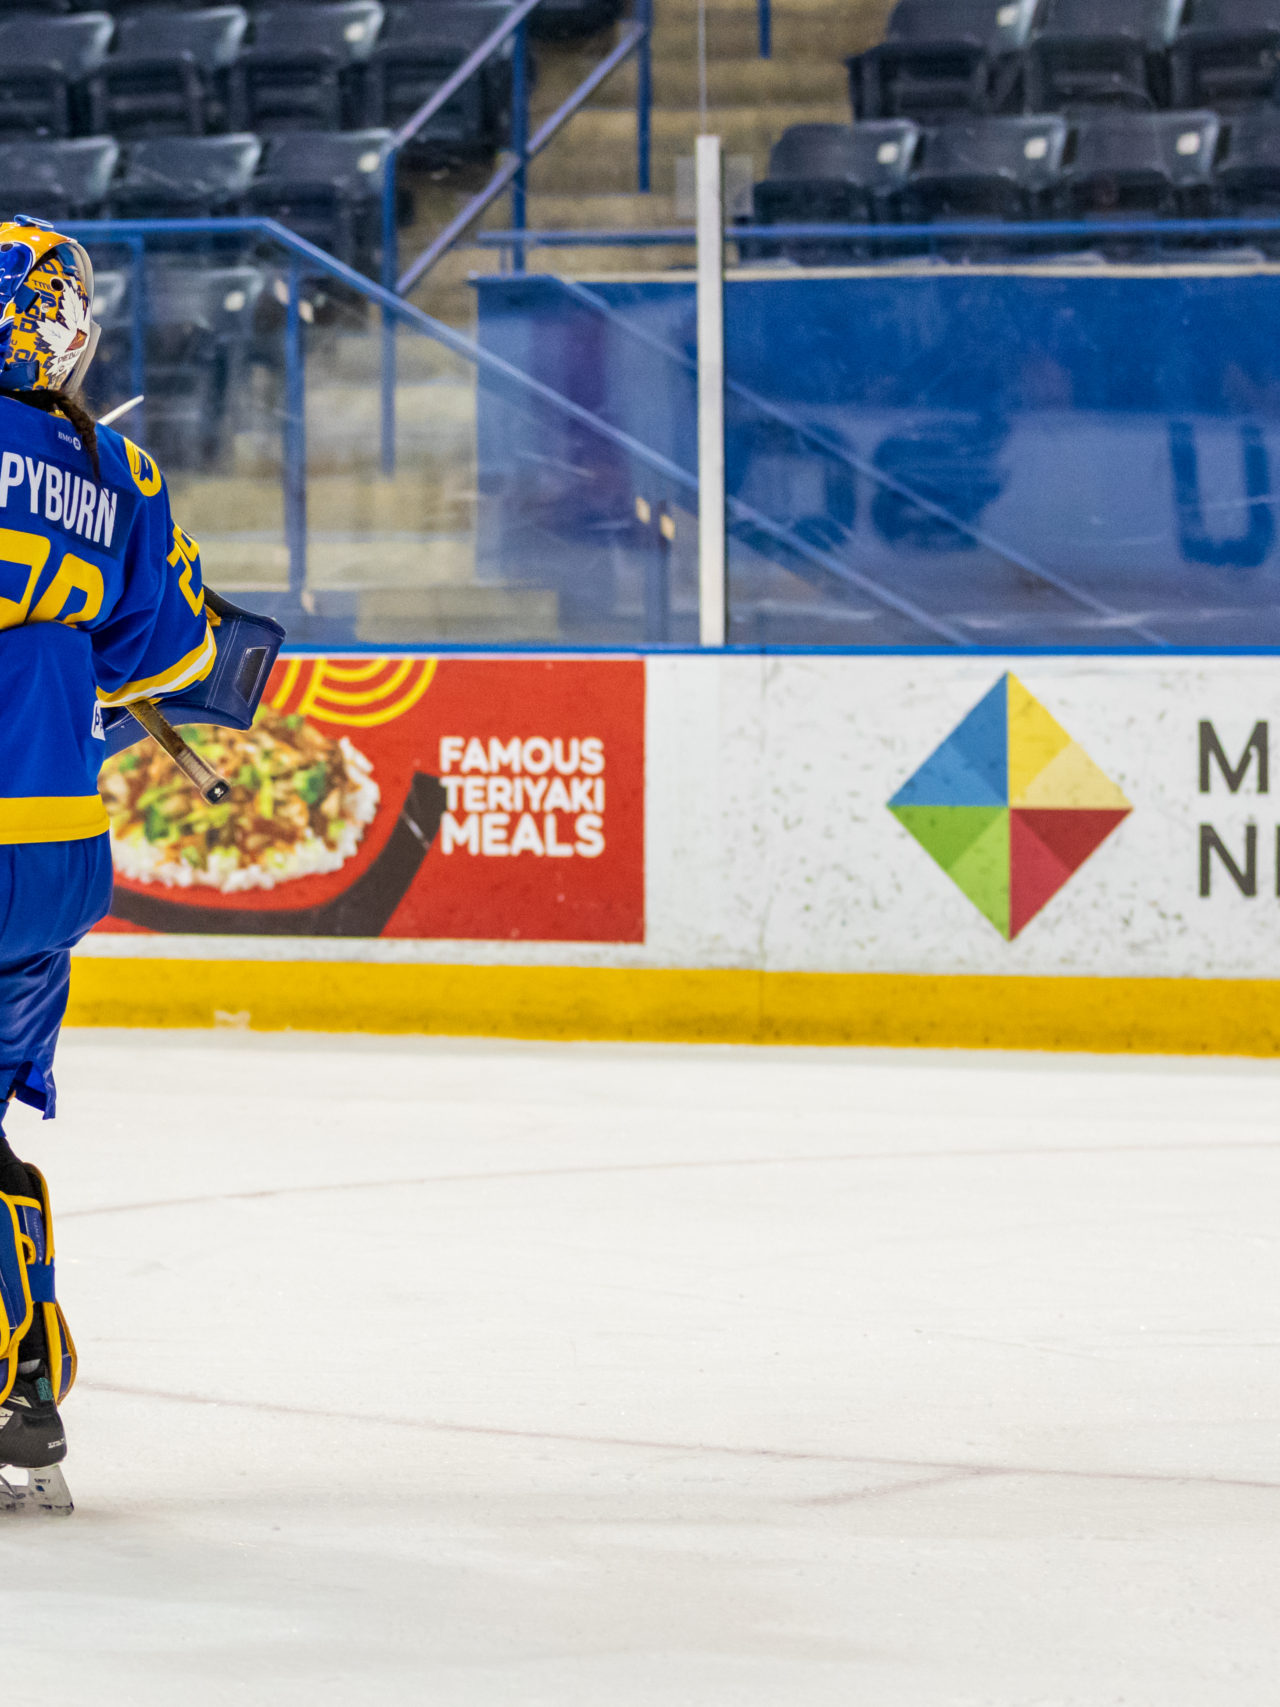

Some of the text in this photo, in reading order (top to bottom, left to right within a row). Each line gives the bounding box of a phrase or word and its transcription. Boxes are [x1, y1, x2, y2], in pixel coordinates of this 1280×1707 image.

[439, 735, 606, 775] FAMOUS
[439, 775, 606, 814] TERIYAKI
[440, 811, 606, 858] MEALS
[1198, 822, 1280, 899] N
